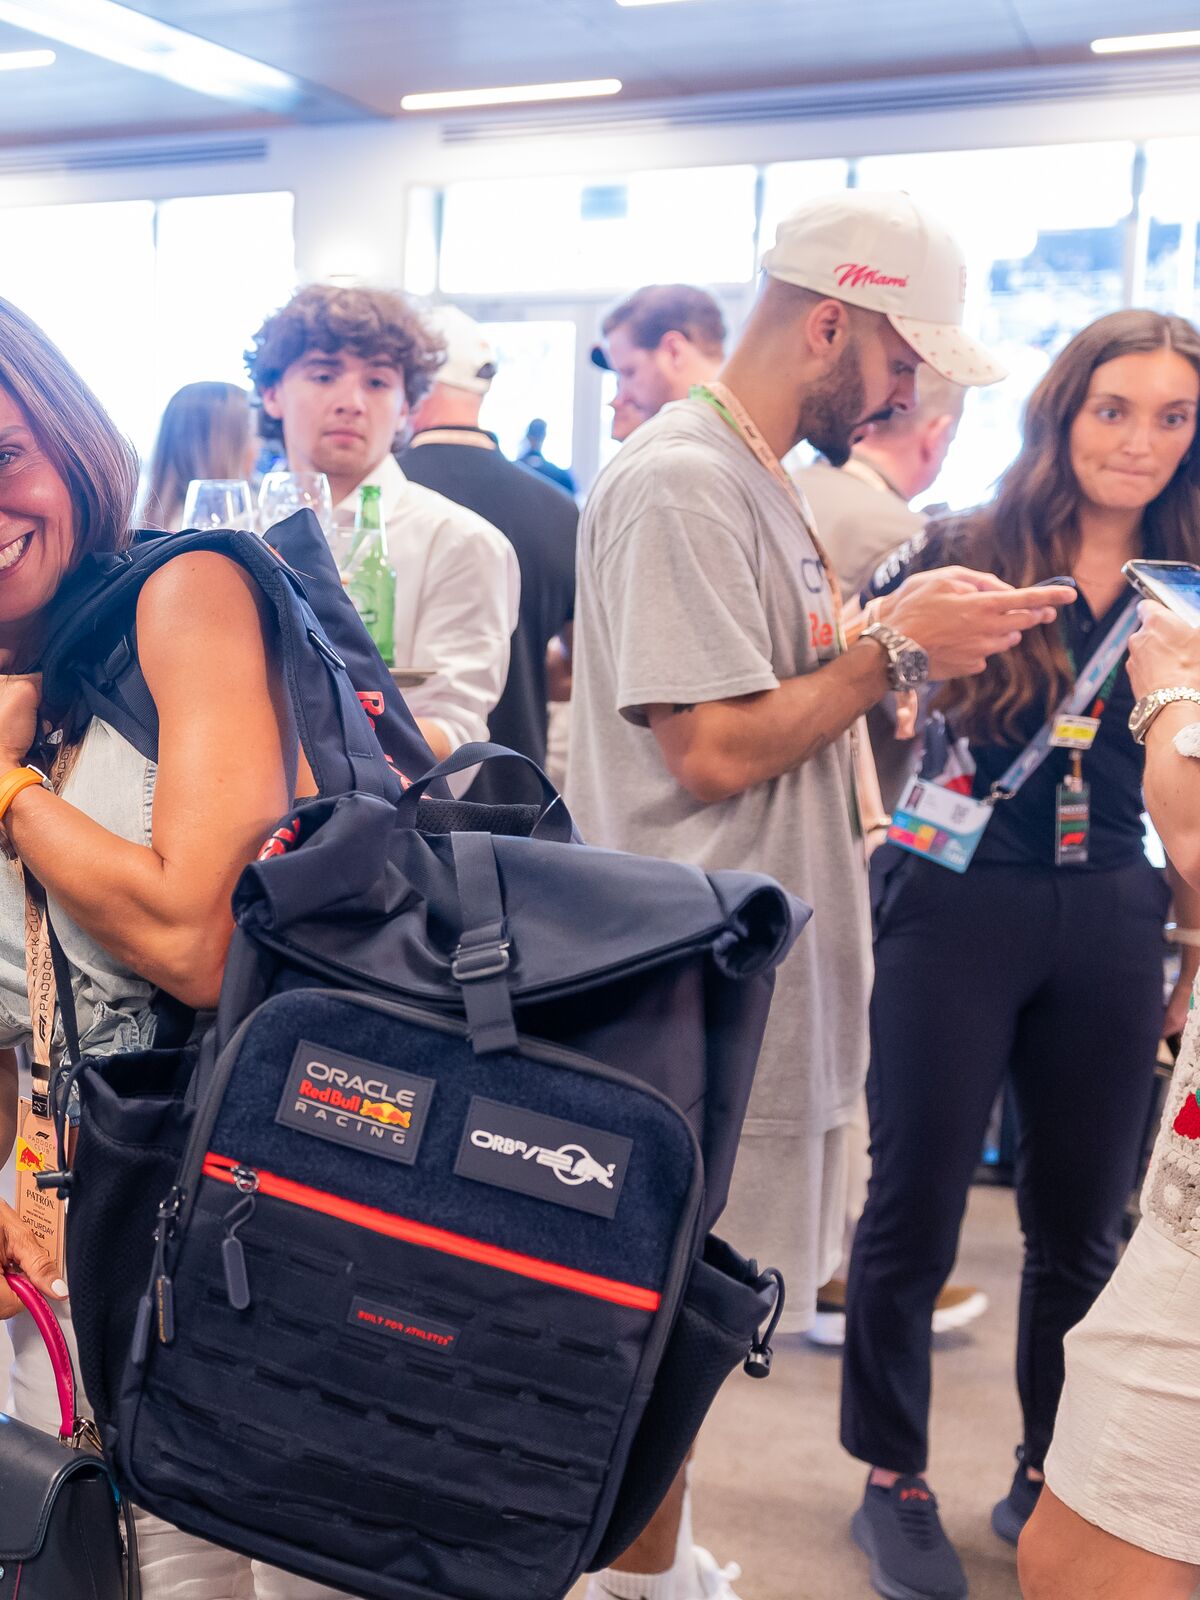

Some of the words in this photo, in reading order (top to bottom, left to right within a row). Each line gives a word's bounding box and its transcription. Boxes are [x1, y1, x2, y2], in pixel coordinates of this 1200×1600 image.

[833, 263, 910, 288] Miami
[306, 1061, 417, 1108] ORACLE
[294, 1101, 407, 1145] RACING
[27, 1135, 55, 1150] PADDOCK
[34, 1144, 49, 1154] CLUB
[22, 1215, 55, 1236] SATURDAY
[357, 1311, 384, 1324] BUILT
[384, 1318, 404, 1331] FOR
